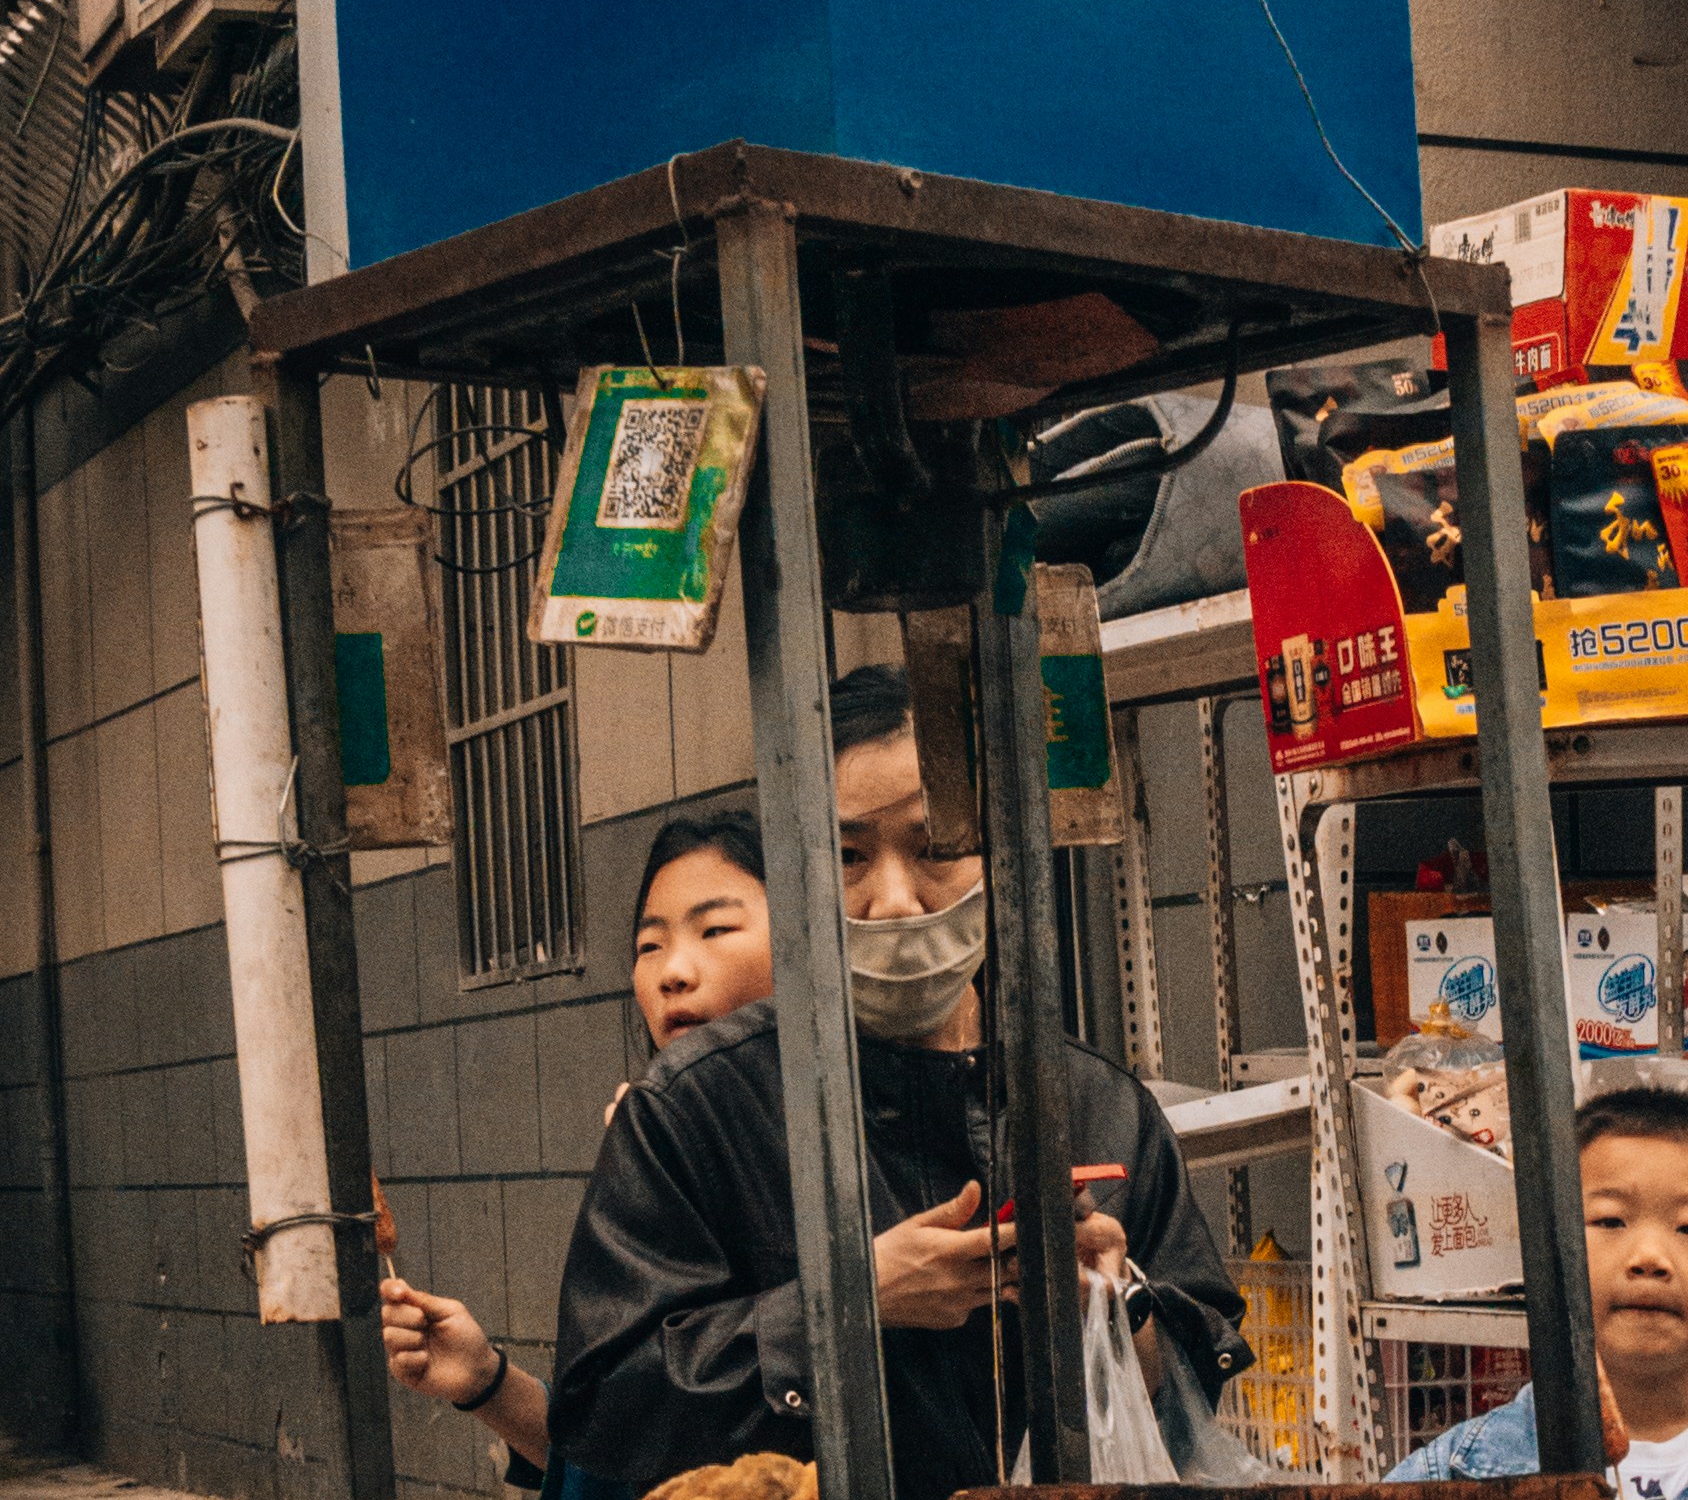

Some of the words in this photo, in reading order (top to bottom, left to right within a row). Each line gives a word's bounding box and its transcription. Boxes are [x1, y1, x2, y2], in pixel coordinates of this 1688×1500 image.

[1337, 625, 1399, 676] 口味王
[1429, 1191, 1488, 1231] 让更多人
[1431, 1222, 1478, 1258] 爱上面包
